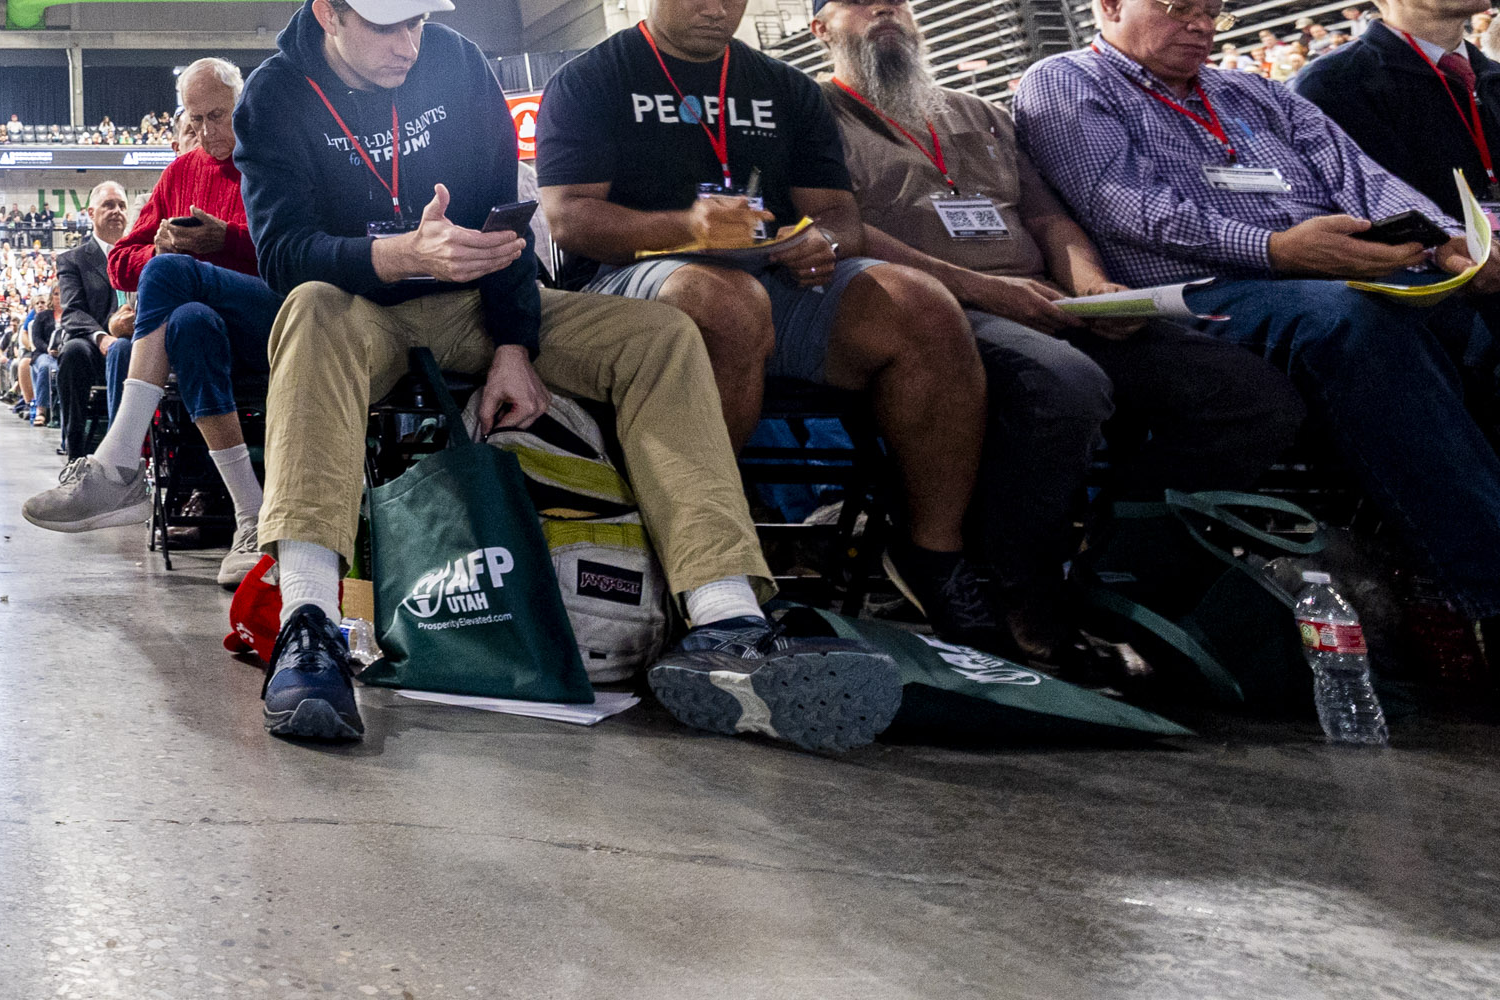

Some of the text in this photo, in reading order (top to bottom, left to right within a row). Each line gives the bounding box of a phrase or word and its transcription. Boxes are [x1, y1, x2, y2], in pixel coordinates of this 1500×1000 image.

[631, 93, 776, 129] PEOPLE
[445, 546, 515, 596] AFP
[446, 591, 490, 614] UTAH
[417, 610, 513, 631] ProsperityElevated.com
